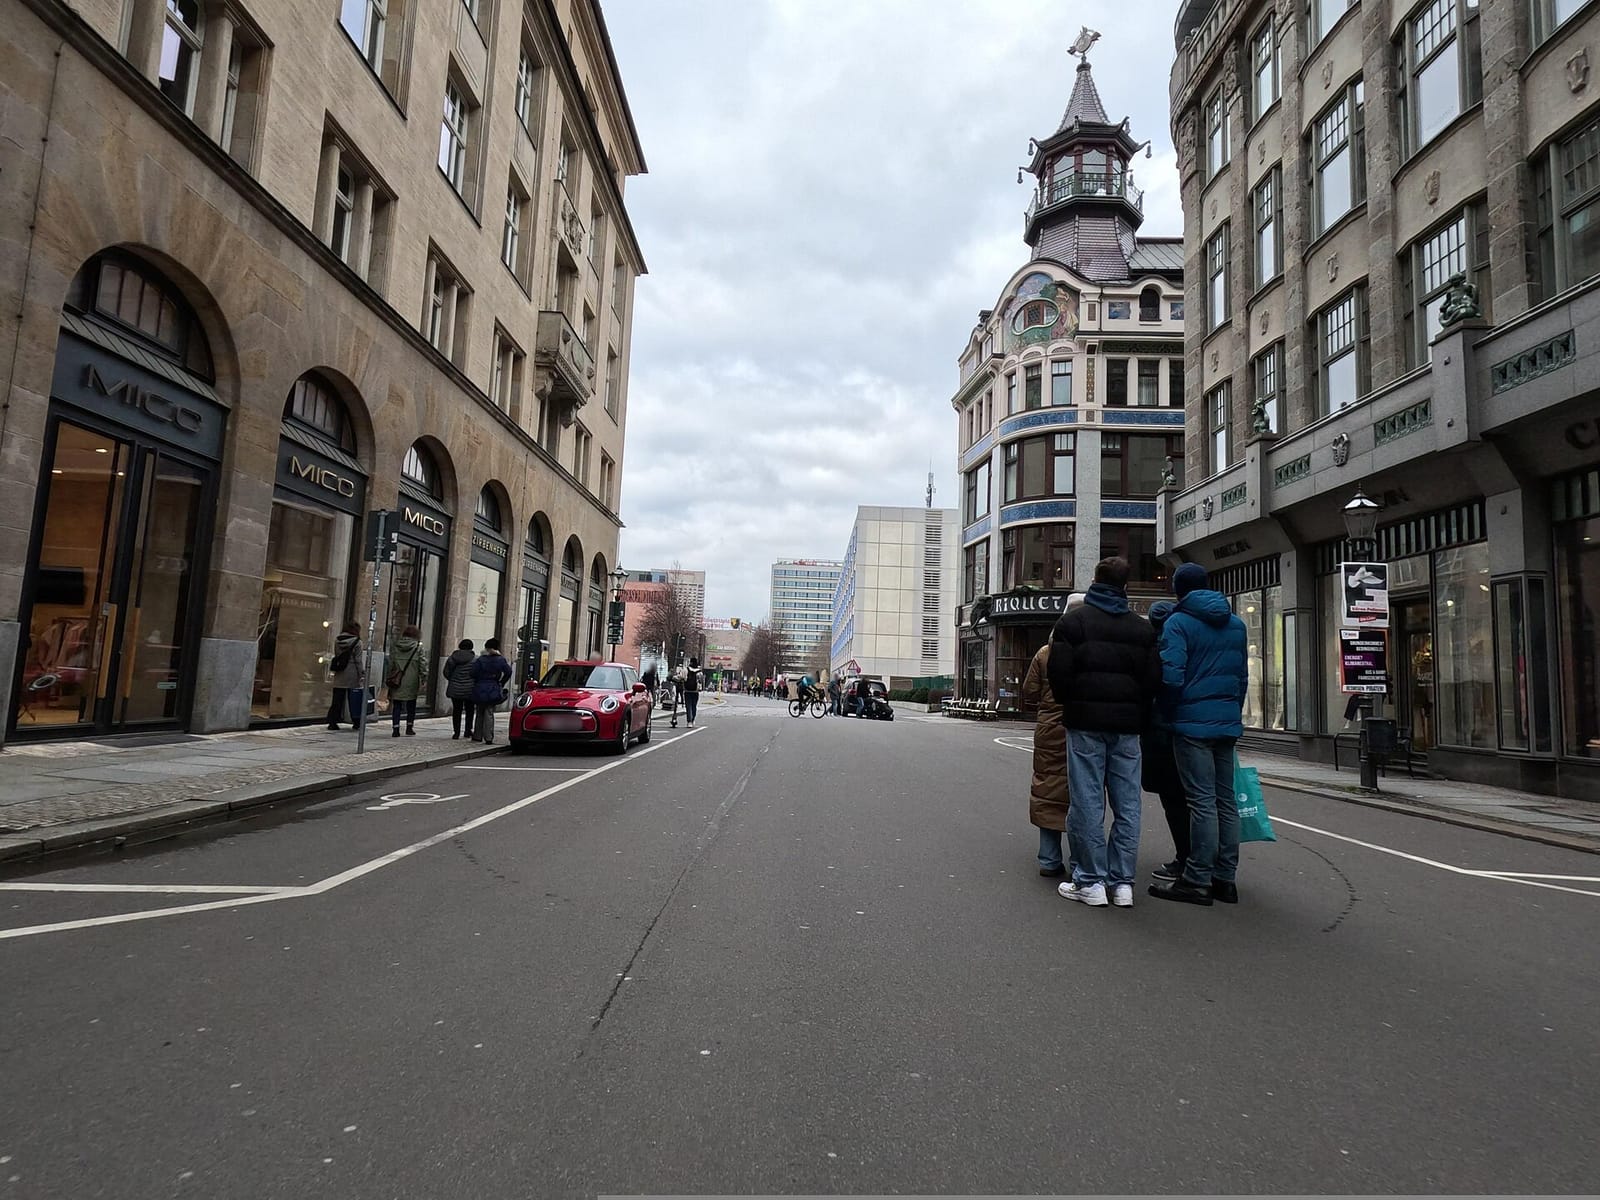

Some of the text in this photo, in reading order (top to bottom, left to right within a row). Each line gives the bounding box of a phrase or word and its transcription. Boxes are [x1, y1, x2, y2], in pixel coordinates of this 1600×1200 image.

[82, 362, 203, 433] MICO
[291, 455, 355, 498] MICO
[405, 506, 444, 536] MICO
[472, 535, 506, 558] ZIRBENHERZ
